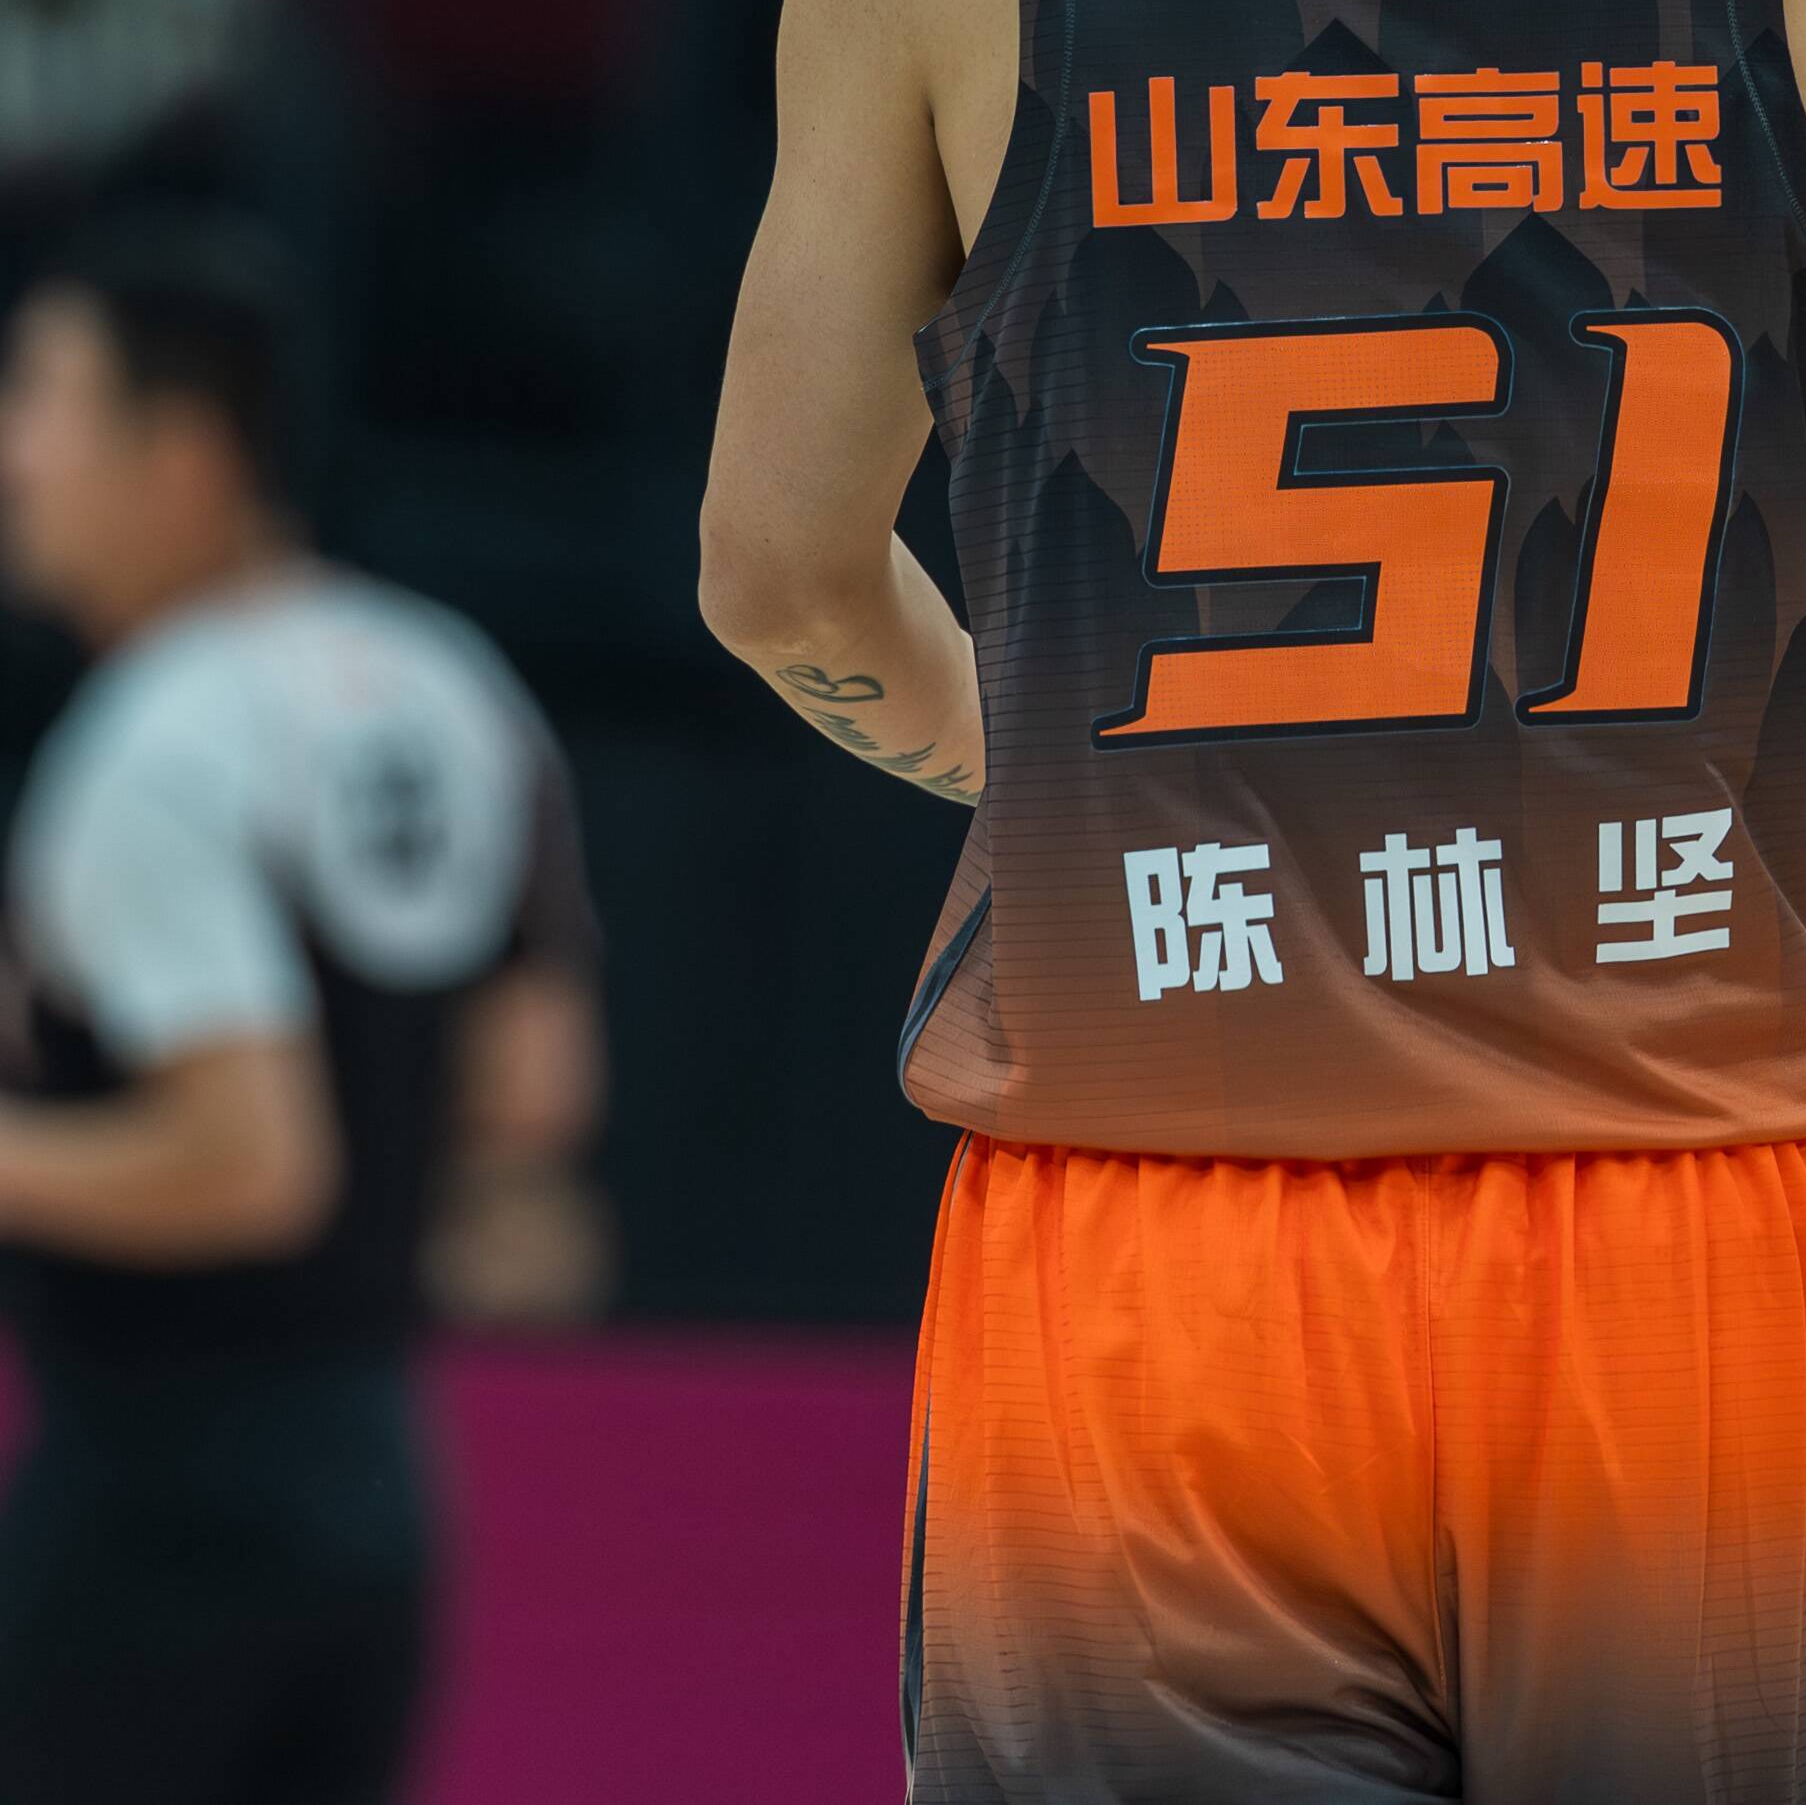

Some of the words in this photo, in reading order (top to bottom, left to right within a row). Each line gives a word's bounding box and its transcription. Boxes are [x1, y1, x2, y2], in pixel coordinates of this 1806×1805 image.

[1088, 61, 1723, 228] 山东高速
[1096, 316, 1739, 743] 51
[1123, 807, 1734, 1002] 陈林坚
